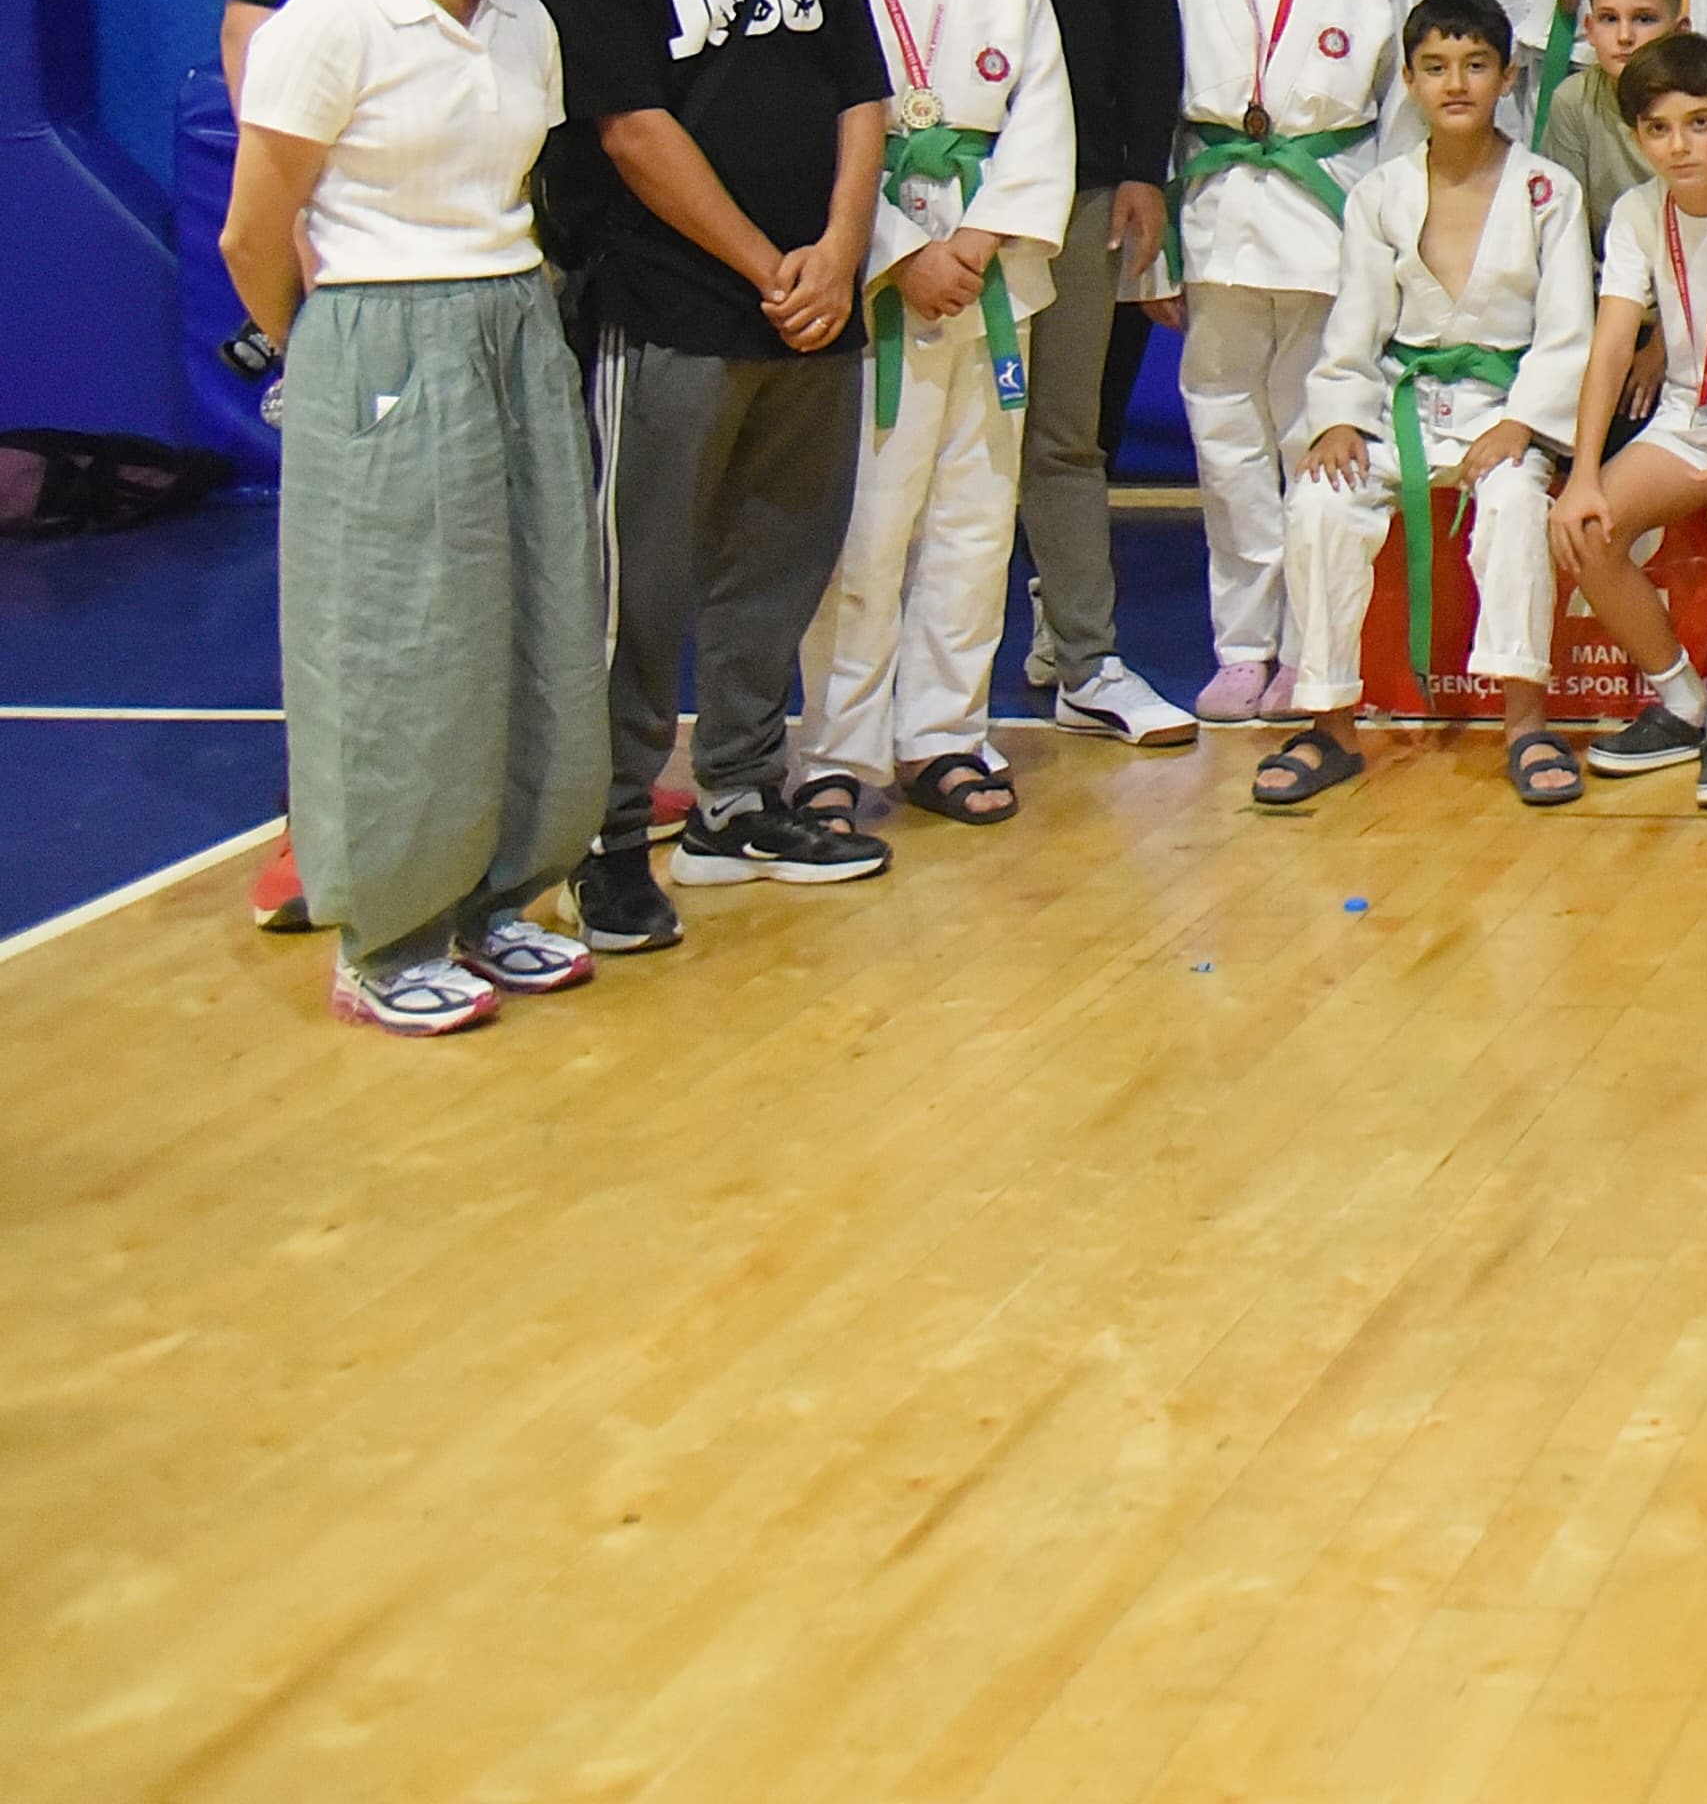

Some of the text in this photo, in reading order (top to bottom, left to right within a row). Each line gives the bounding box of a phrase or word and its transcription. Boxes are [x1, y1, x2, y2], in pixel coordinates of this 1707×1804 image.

[1572, 645, 1627, 664] MAN
[1428, 674, 1503, 698] GENÇL
[1567, 675, 1630, 696] SPOR
